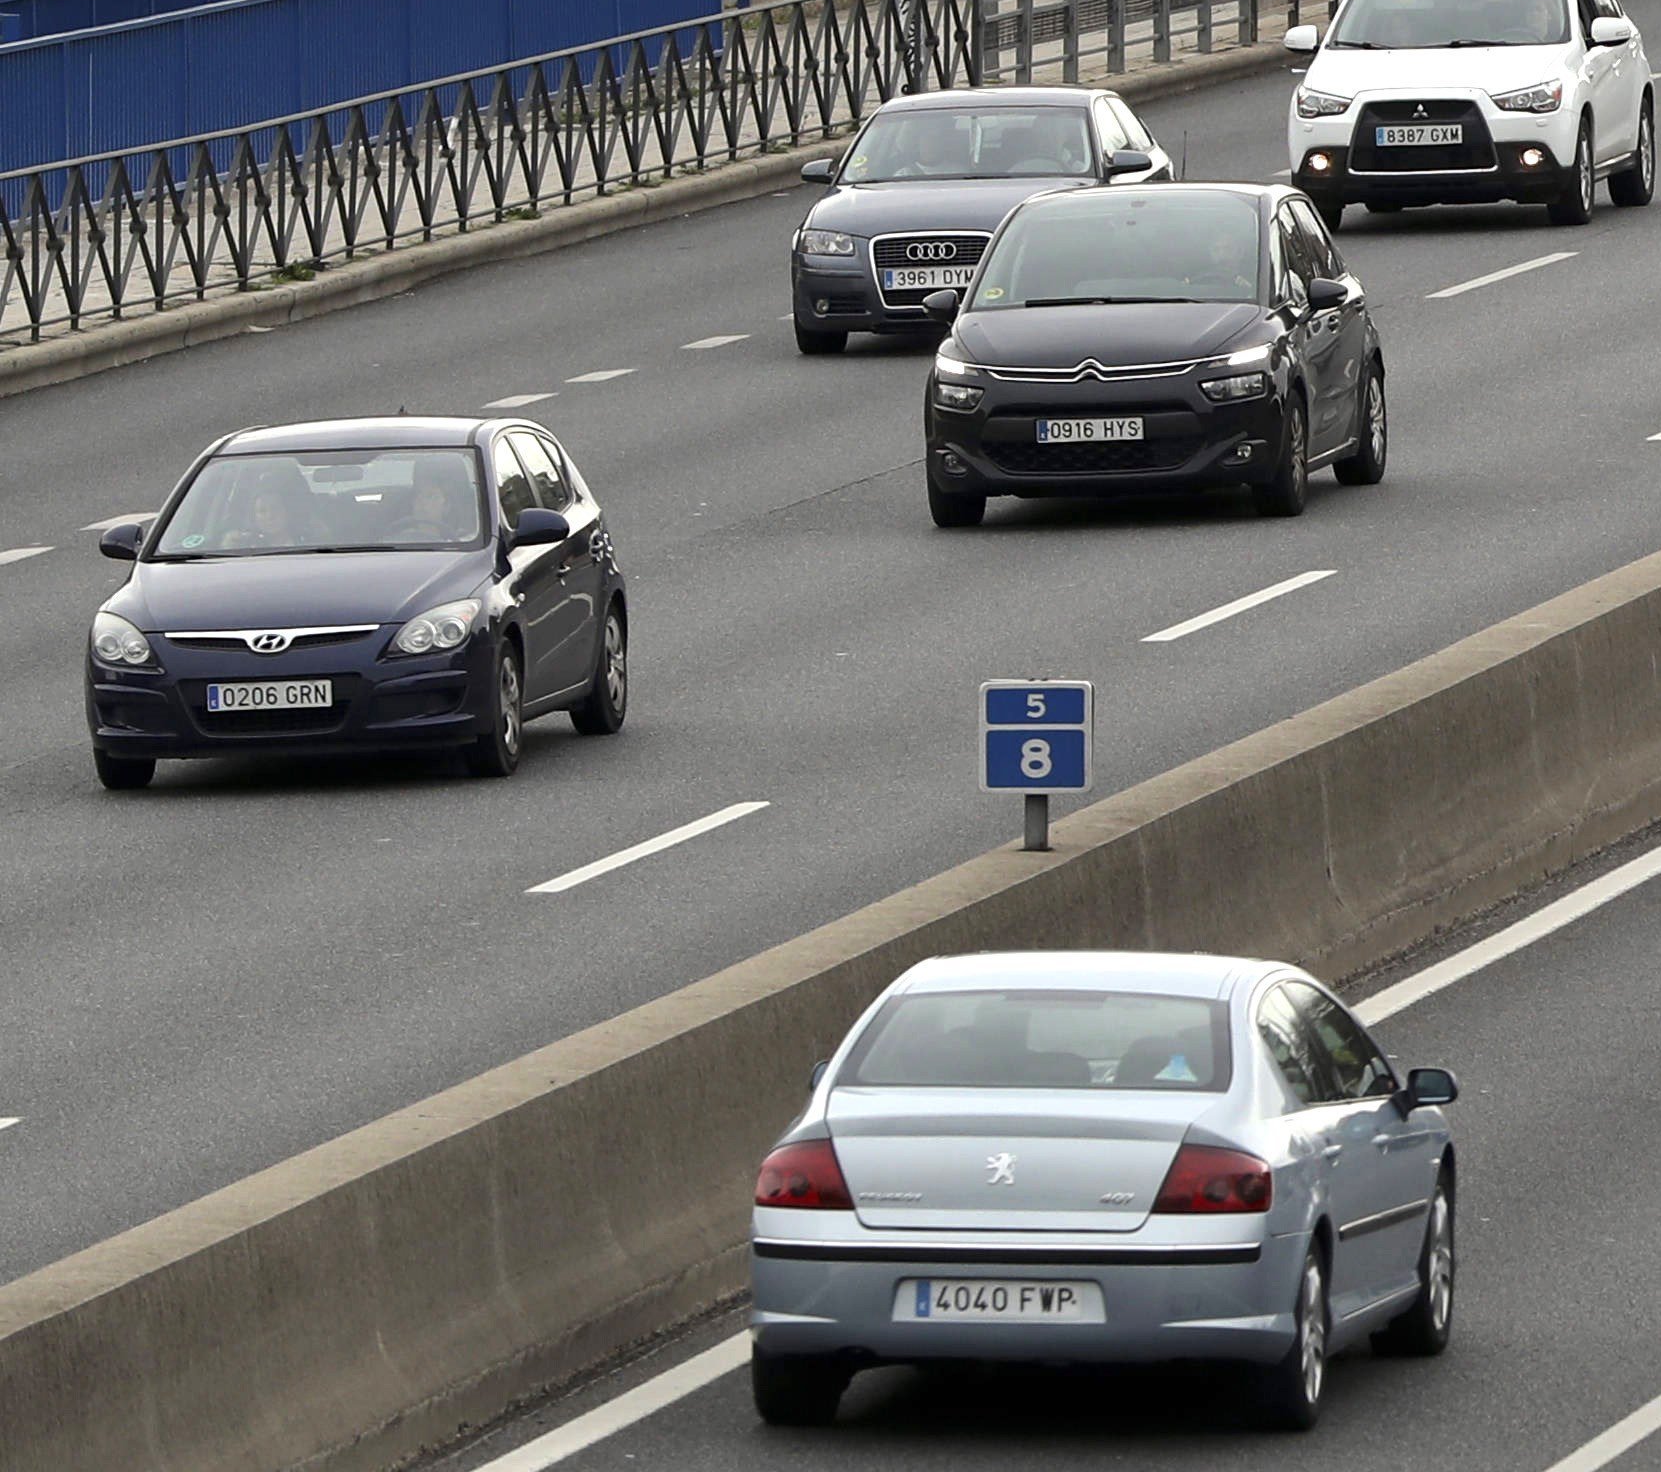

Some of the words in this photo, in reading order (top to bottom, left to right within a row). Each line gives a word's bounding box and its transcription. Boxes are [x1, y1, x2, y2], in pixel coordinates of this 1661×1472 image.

[1387, 128, 1425, 143] 8387
[1431, 128, 1460, 142] GXM
[897, 271, 936, 286] 3961
[1050, 422, 1094, 439] 0916
[1103, 419, 1140, 438] HYS
[223, 686, 278, 707] 0206
[285, 684, 327, 704] GRN
[1026, 694, 1046, 718] 5
[1020, 738, 1053, 779] 8
[936, 1287, 1009, 1312] 4040
[1020, 1287, 1073, 1313] FWP
